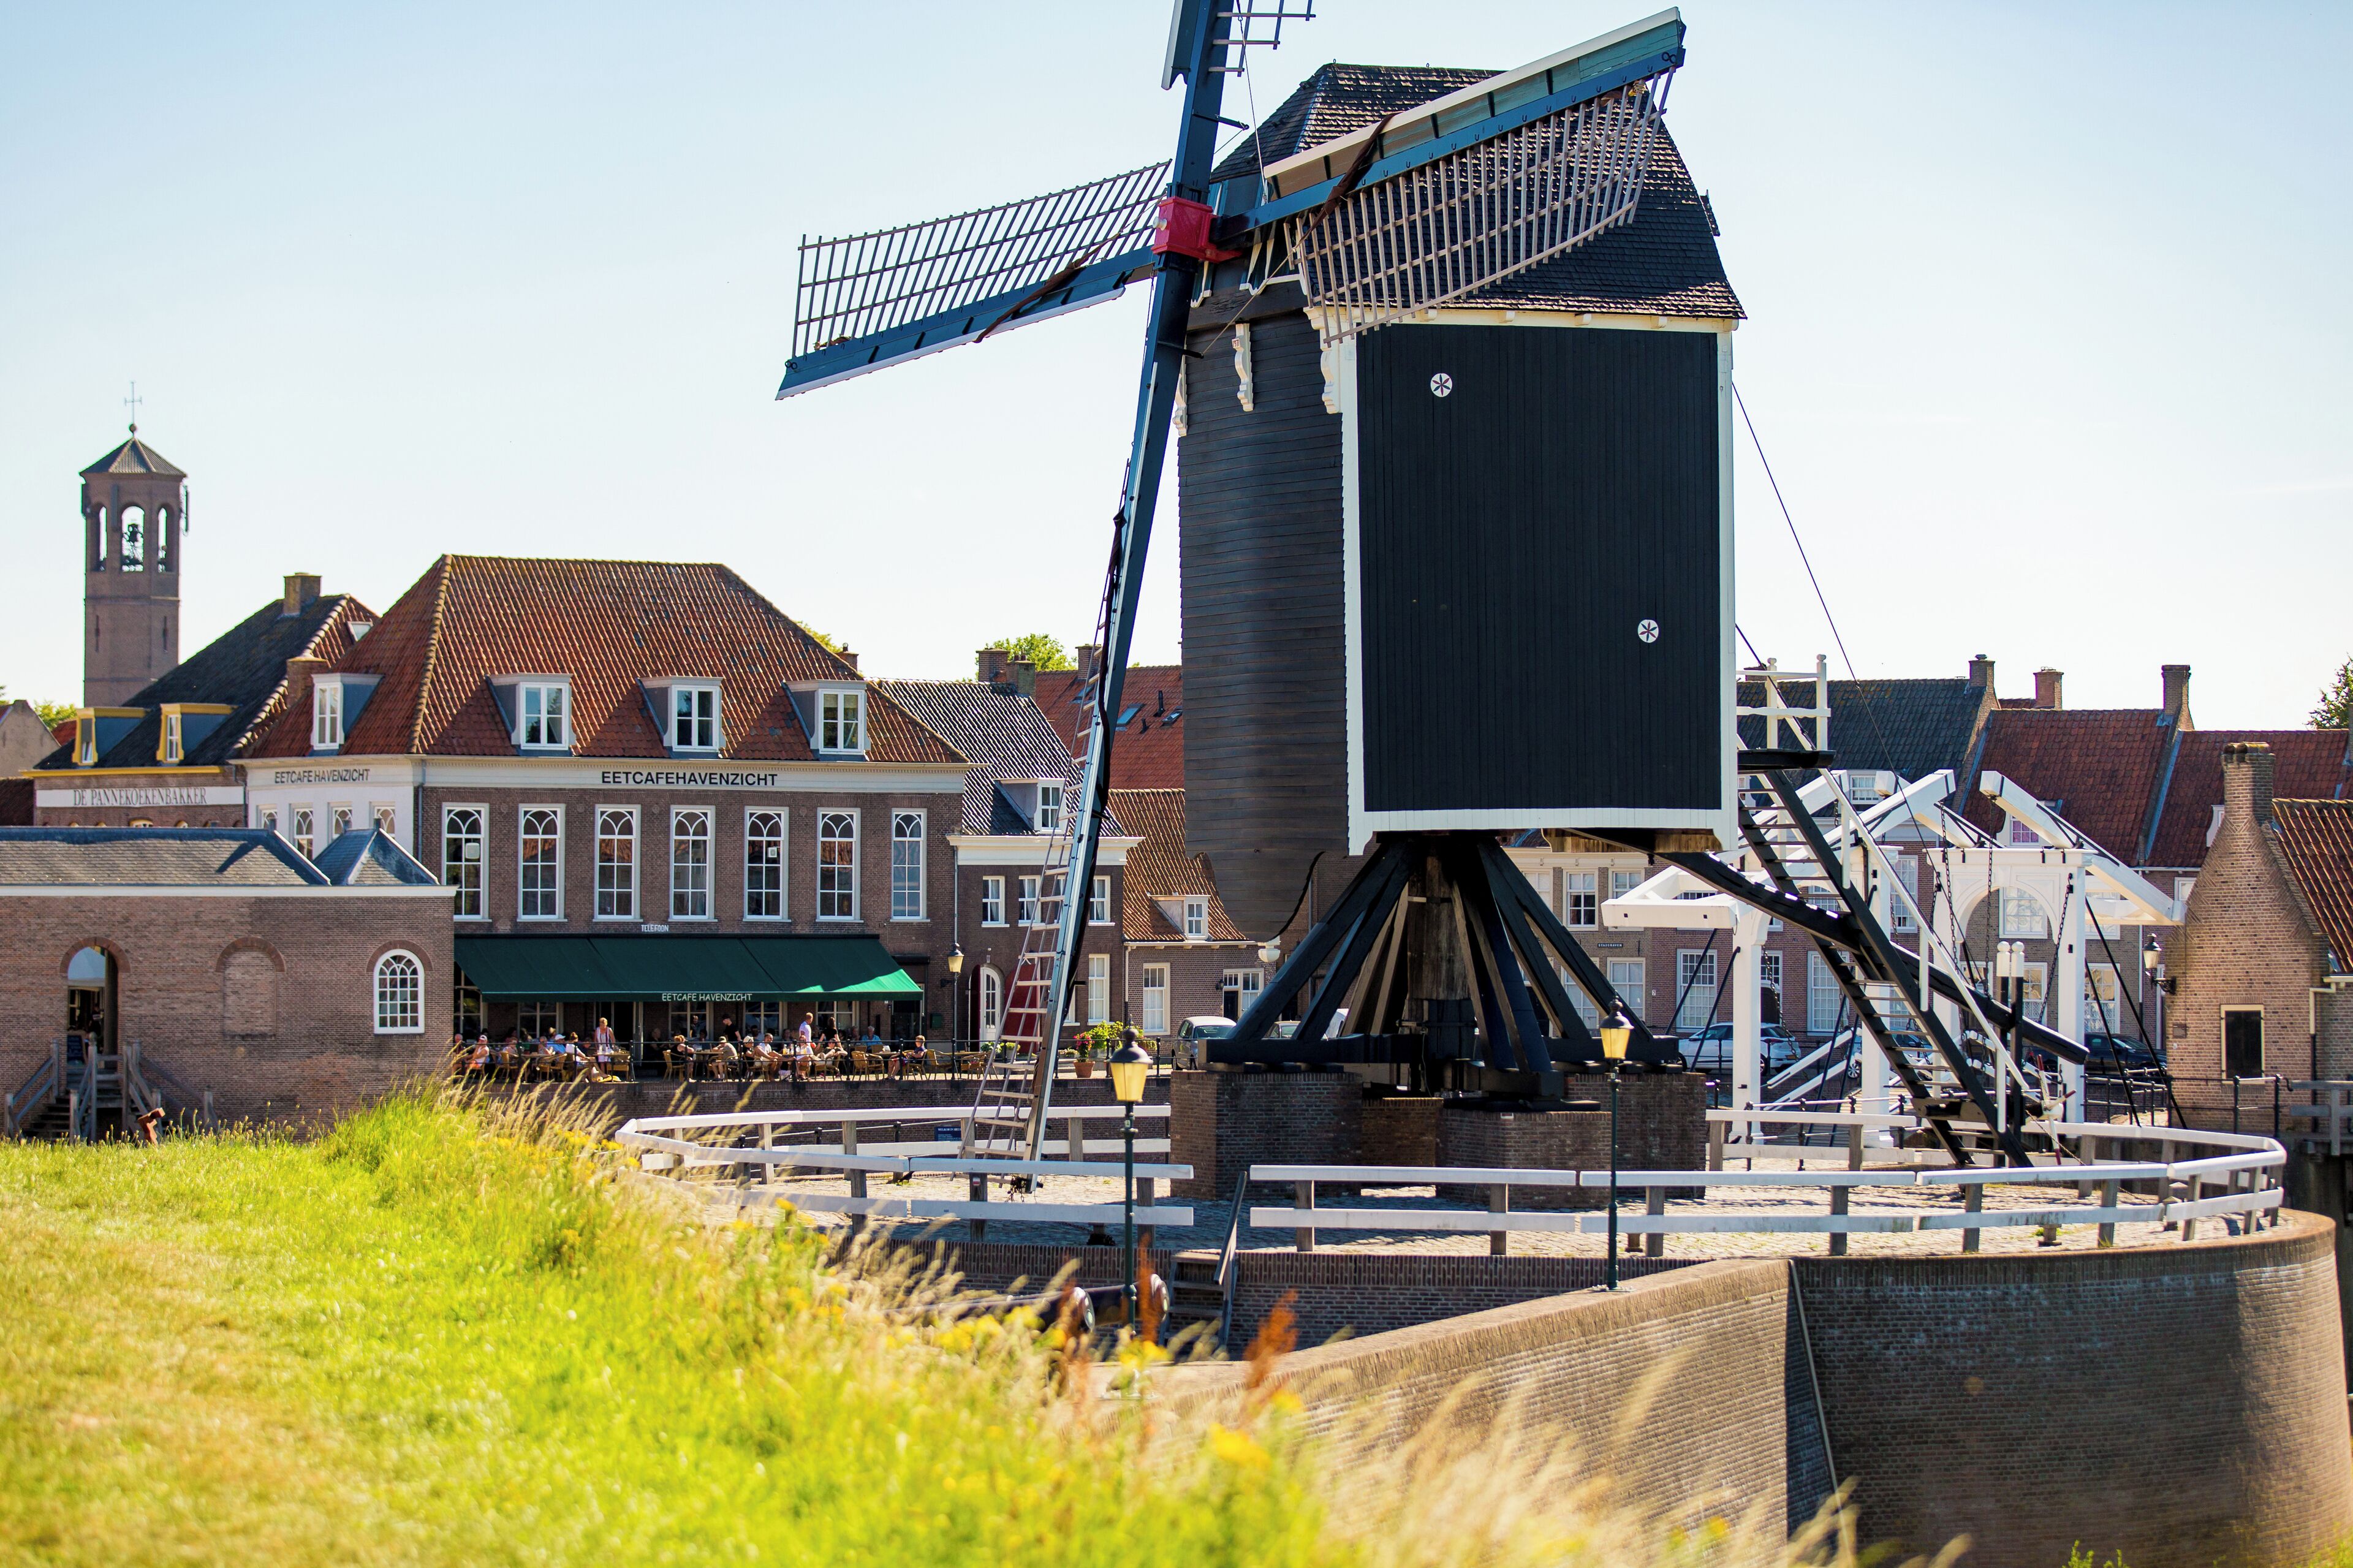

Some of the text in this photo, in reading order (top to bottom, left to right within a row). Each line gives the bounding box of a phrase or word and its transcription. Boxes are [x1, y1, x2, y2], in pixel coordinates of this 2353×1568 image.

[275, 768, 370, 784] EETCAFE HAVENZICHT
[73, 787, 208, 806] DE PANNEKOEKENBAKKER
[662, 993, 752, 1001] EETCAFE HAVENZICHT
